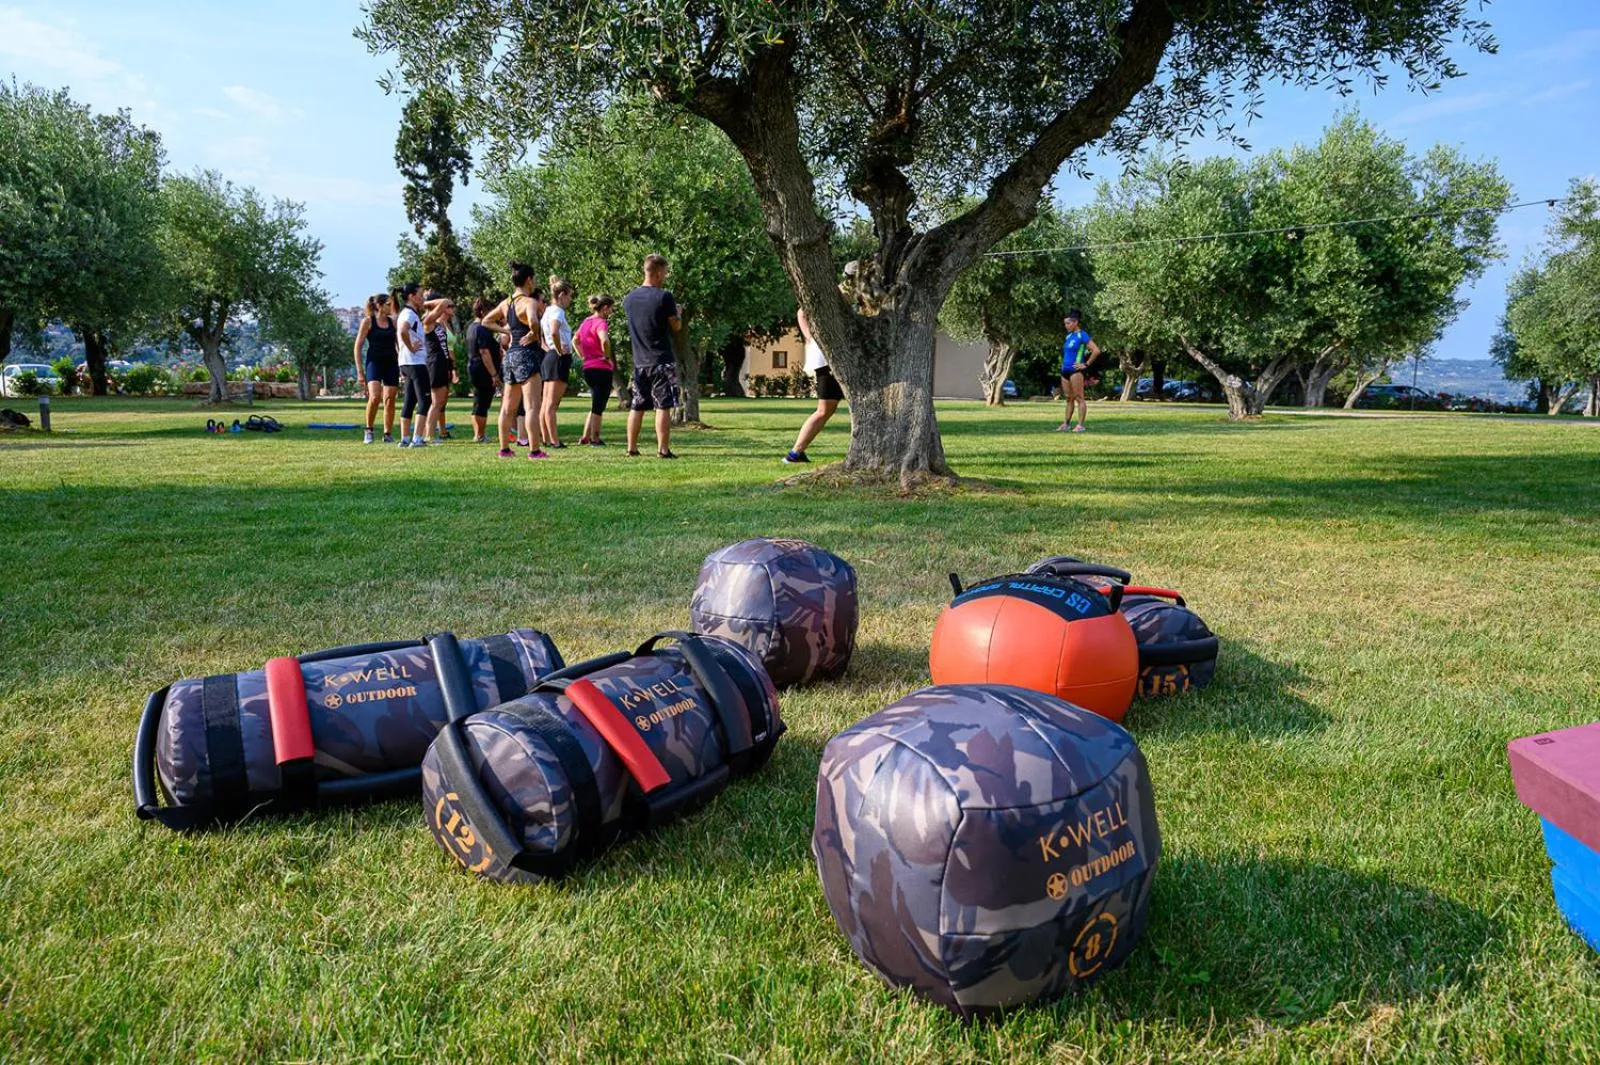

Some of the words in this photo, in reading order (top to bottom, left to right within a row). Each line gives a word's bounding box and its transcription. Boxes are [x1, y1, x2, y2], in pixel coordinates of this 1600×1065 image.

[346, 686, 417, 704] OUTDOOR
[649, 698, 696, 724] OUTDOOR
[445, 809, 475, 854] 12
[1071, 840, 1136, 887] OUTDOOR
[1085, 933, 1101, 961] 8
